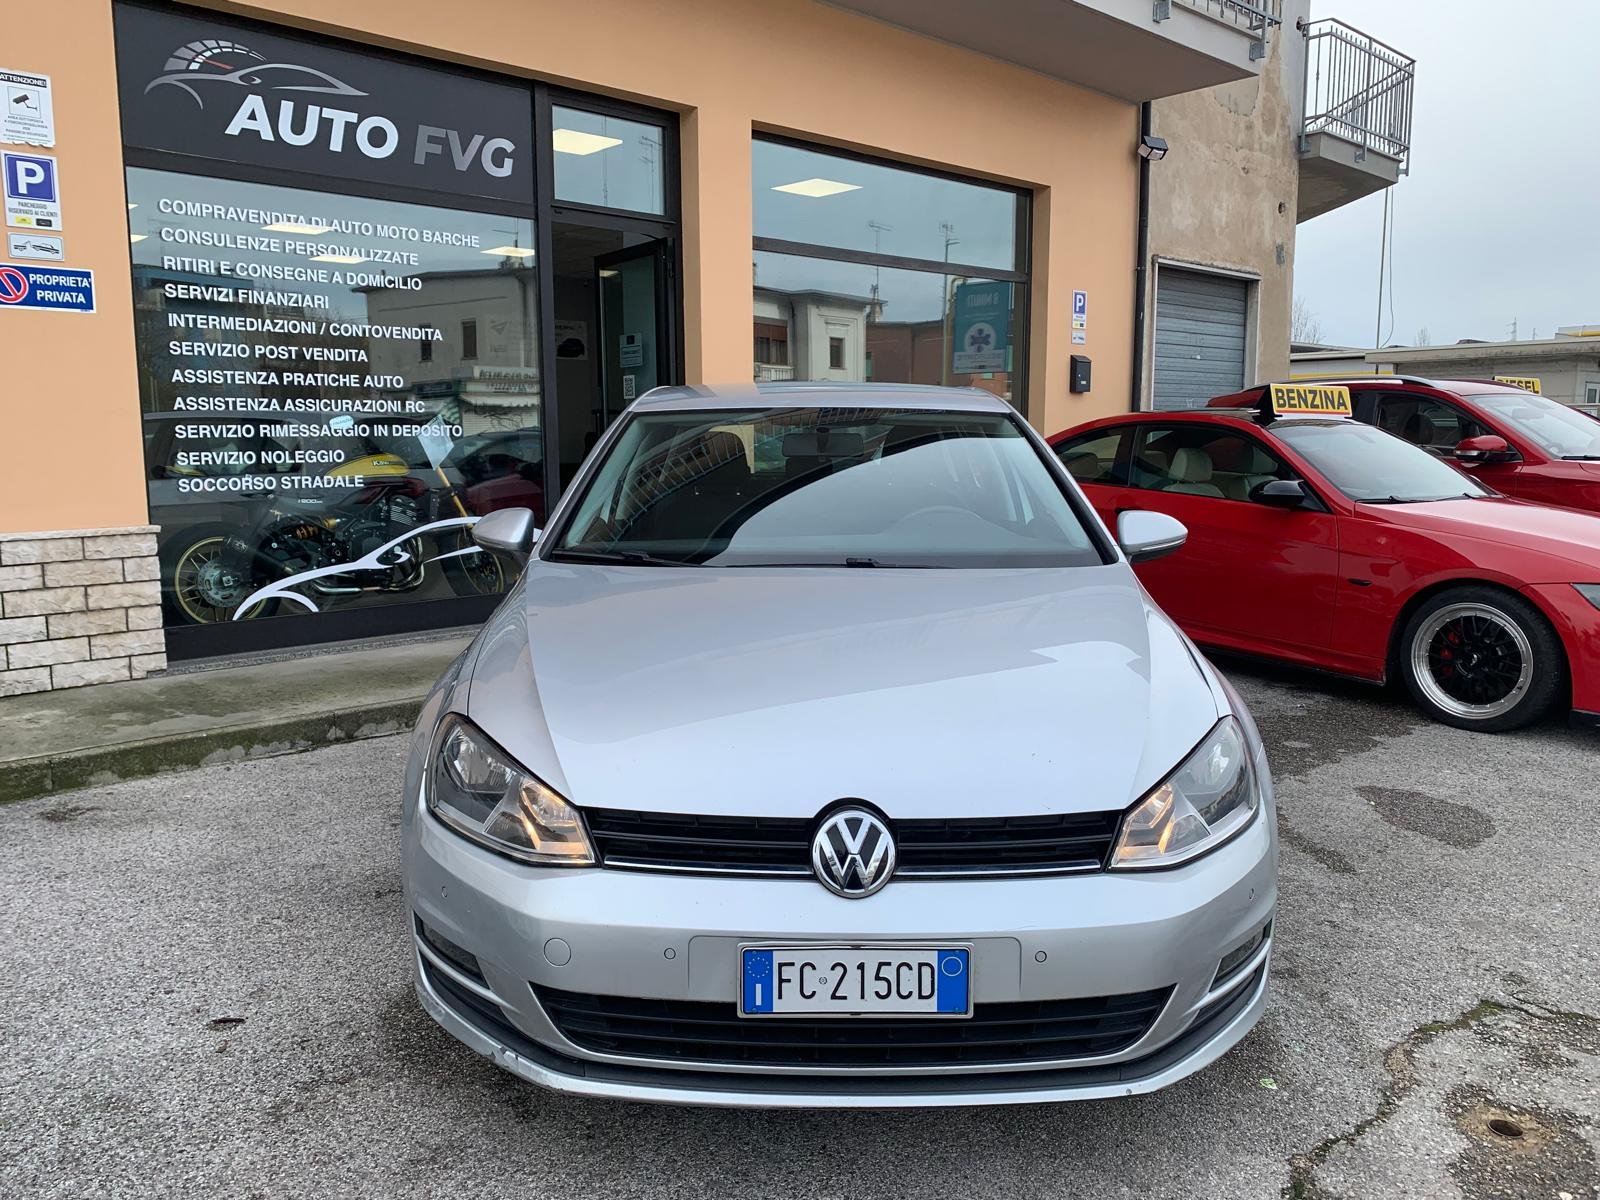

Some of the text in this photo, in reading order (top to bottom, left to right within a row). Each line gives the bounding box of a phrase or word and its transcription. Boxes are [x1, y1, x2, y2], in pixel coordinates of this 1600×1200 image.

[0, 73, 46, 86] ATTENZIONE!
[224, 94, 516, 178] AUTO FVG
[16, 160, 45, 194] P
[159, 198, 480, 248] COMPRAVENDITA DI AUTO MOTO BARCHE
[161, 227, 419, 265] CONSULENZE PERSONALIZZATE
[163, 256, 422, 291] RITIRI E CONSEGNE A DOMICILIO
[36, 289, 86, 304] PRIVATA
[164, 284, 329, 309] SERVIZI FINANZIARI
[1076, 294, 1084, 312] P
[168, 313, 316, 334] INTERMEDIAZIONI
[329, 323, 443, 341] CONTOVENDITA
[169, 341, 368, 363] SERVIZIO POST VENDITA
[172, 369, 279, 385] ASSISTENZA
[283, 372, 360, 387] PRATICHE
[363, 375, 404, 389] AUTO
[1497, 380, 1540, 394] SEL
[173, 397, 425, 413] ASSISTENZA ASSICURAZIONI RC
[1274, 388, 1348, 410] BENZINA
[175, 424, 462, 439] SERVIZIO RIMESSAGGIO IN DEPOSITO
[176, 450, 345, 465] SERVIZIO NOLEGGIO
[178, 475, 364, 492] SOCCORSO STRADALE
